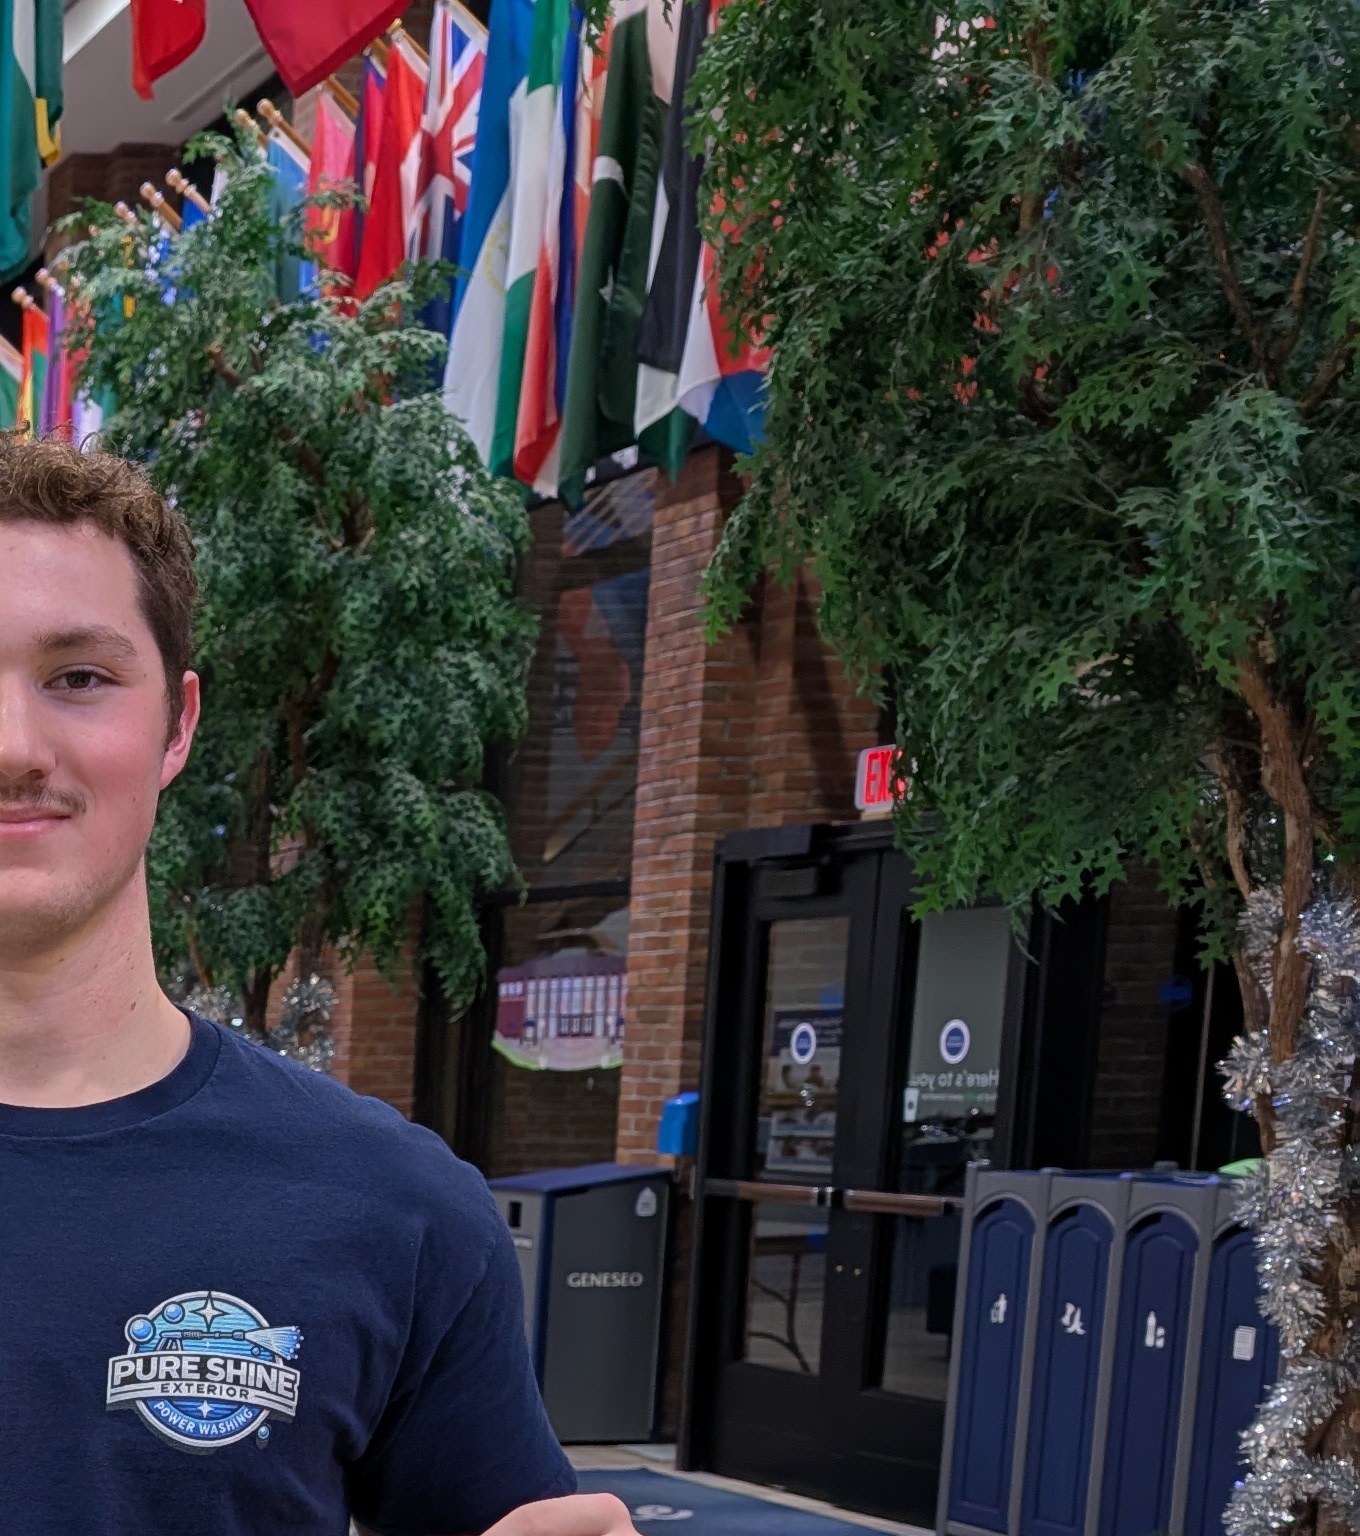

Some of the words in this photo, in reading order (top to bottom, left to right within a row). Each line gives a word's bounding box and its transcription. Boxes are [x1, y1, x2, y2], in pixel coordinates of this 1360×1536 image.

[567, 1271, 643, 1288] GENESEO
[112, 1355, 201, 1386] PURE
[204, 1356, 298, 1398] SHINE
[160, 1381, 250, 1400] EXTERIOR
[153, 1400, 197, 1435] POWER
[198, 1407, 255, 1436] WASHING
